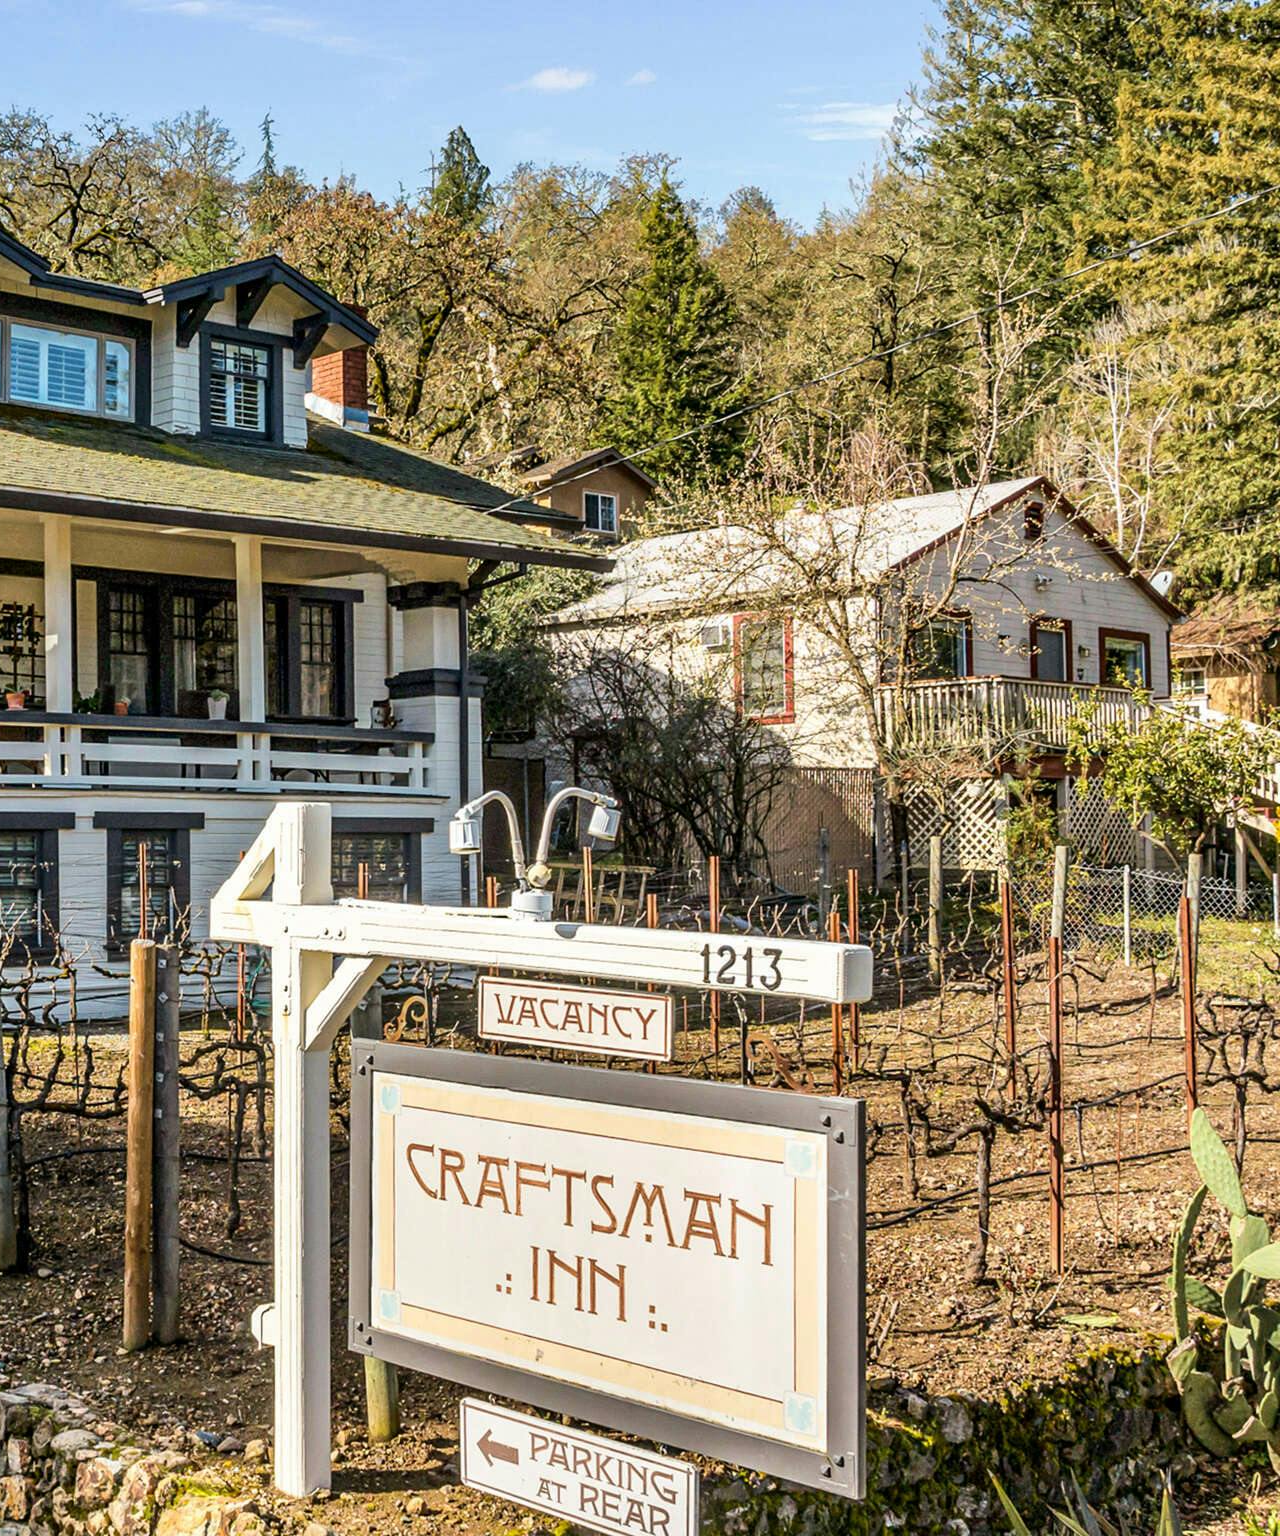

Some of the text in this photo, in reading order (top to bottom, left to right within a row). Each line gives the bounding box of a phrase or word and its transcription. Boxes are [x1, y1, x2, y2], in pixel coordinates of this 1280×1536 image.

[700, 944, 783, 990] 1213
[496, 993, 657, 1040] VACANCY
[406, 1143, 774, 1266] CRAFTSMAN
[530, 1246, 627, 1321] INN
[529, 1433, 678, 1504] PARKING
[537, 1478, 670, 1536] AT REAR
